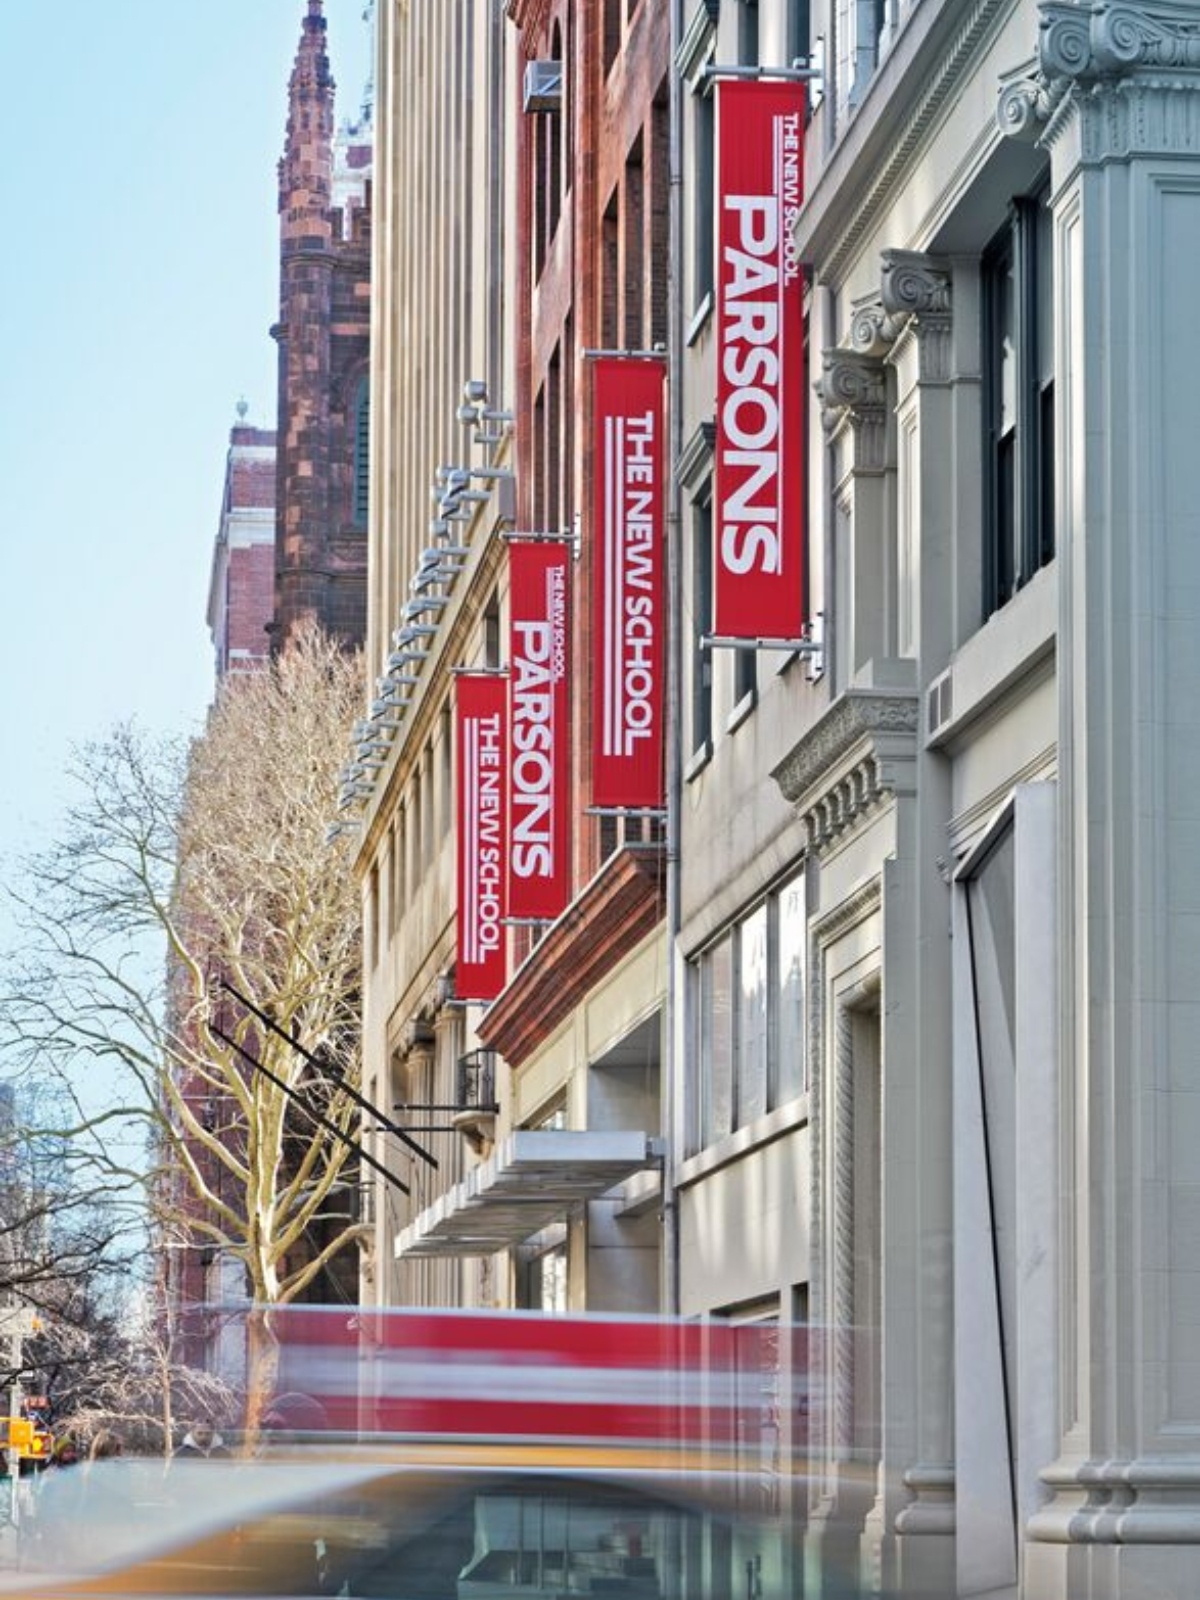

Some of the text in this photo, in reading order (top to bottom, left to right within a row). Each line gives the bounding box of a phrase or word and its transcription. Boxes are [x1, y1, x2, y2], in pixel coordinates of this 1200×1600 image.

[784, 112, 799, 150] THE
[784, 153, 799, 204] NEW
[721, 194, 780, 576] PARSONS
[553, 564, 565, 684] THE NEW SCHOOL
[625, 410, 654, 756] THE NEW SCHOOL
[479, 712, 501, 965] THE NEW SCHOOL
[512, 620, 552, 879] PARSONS
